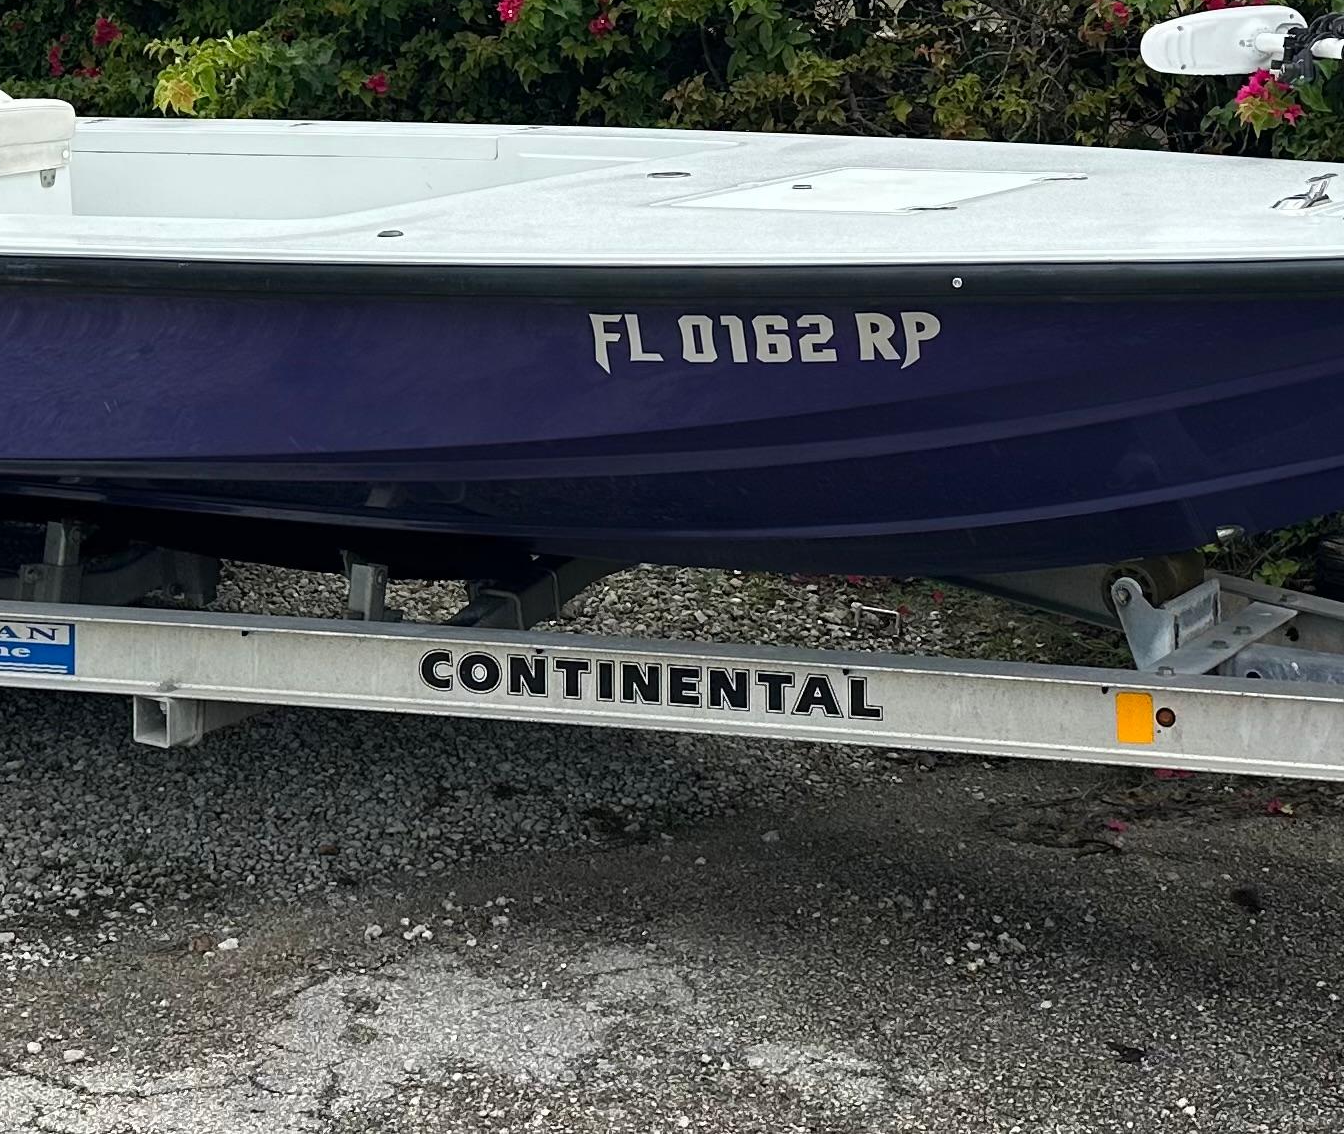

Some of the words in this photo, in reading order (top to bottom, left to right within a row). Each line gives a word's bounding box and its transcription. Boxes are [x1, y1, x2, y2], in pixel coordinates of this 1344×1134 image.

[589, 313, 664, 374] FL
[677, 314, 838, 363] 0162
[855, 312, 941, 369] RP
[419, 649, 883, 721] CONTINENTAL
